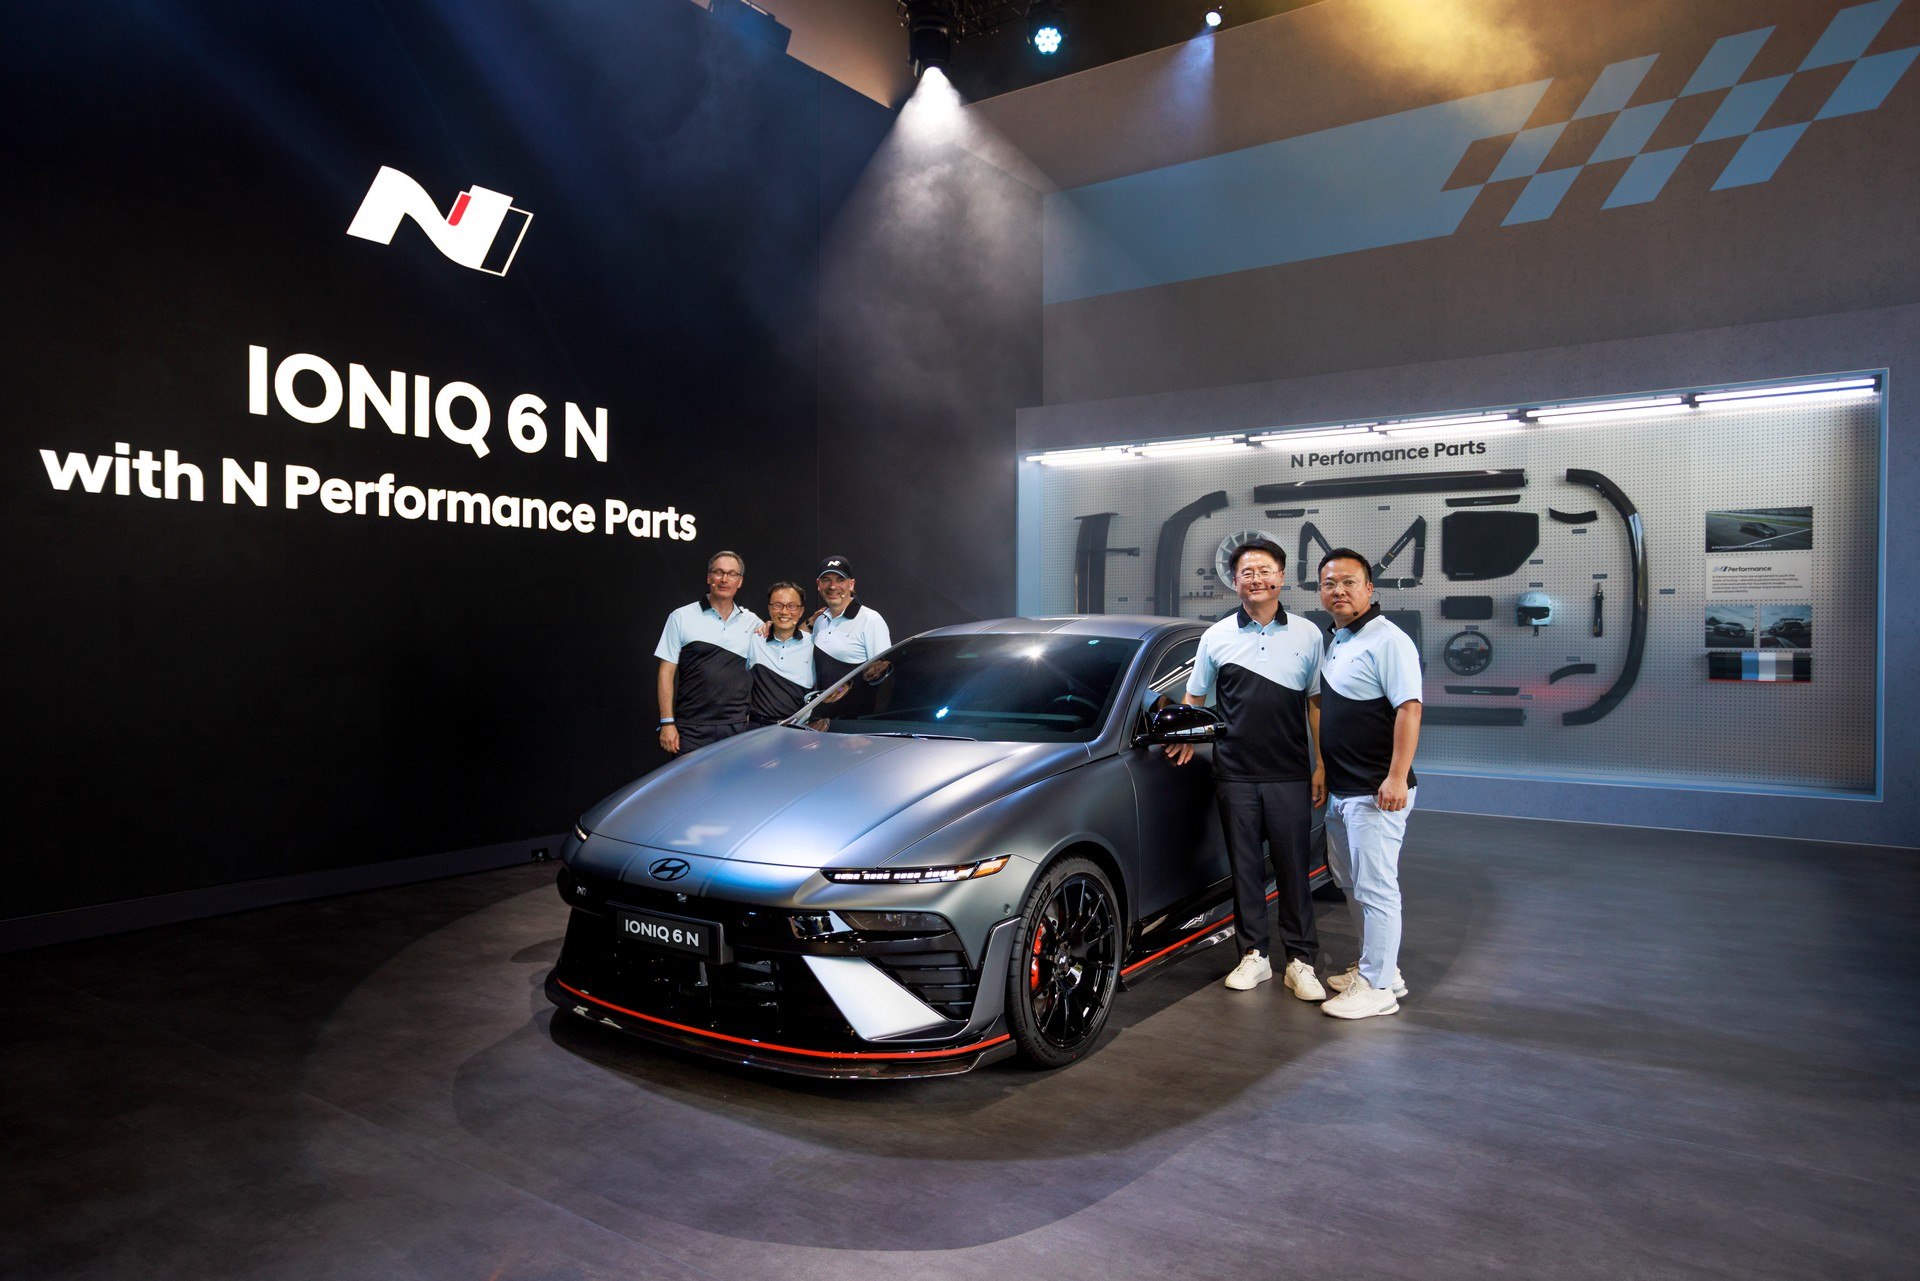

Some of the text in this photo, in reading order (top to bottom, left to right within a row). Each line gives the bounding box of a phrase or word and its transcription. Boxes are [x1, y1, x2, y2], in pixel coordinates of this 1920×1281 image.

[347, 166, 533, 277] N
[249, 345, 607, 462] IONIQ 6 N
[1290, 440, 1486, 468] N Performance Parts
[40, 442, 696, 541] with N Performance Parts
[1030, 888, 1049, 930] ZERO
[624, 919, 699, 947] IONIQ 6 N
[1058, 955, 1067, 964] N
